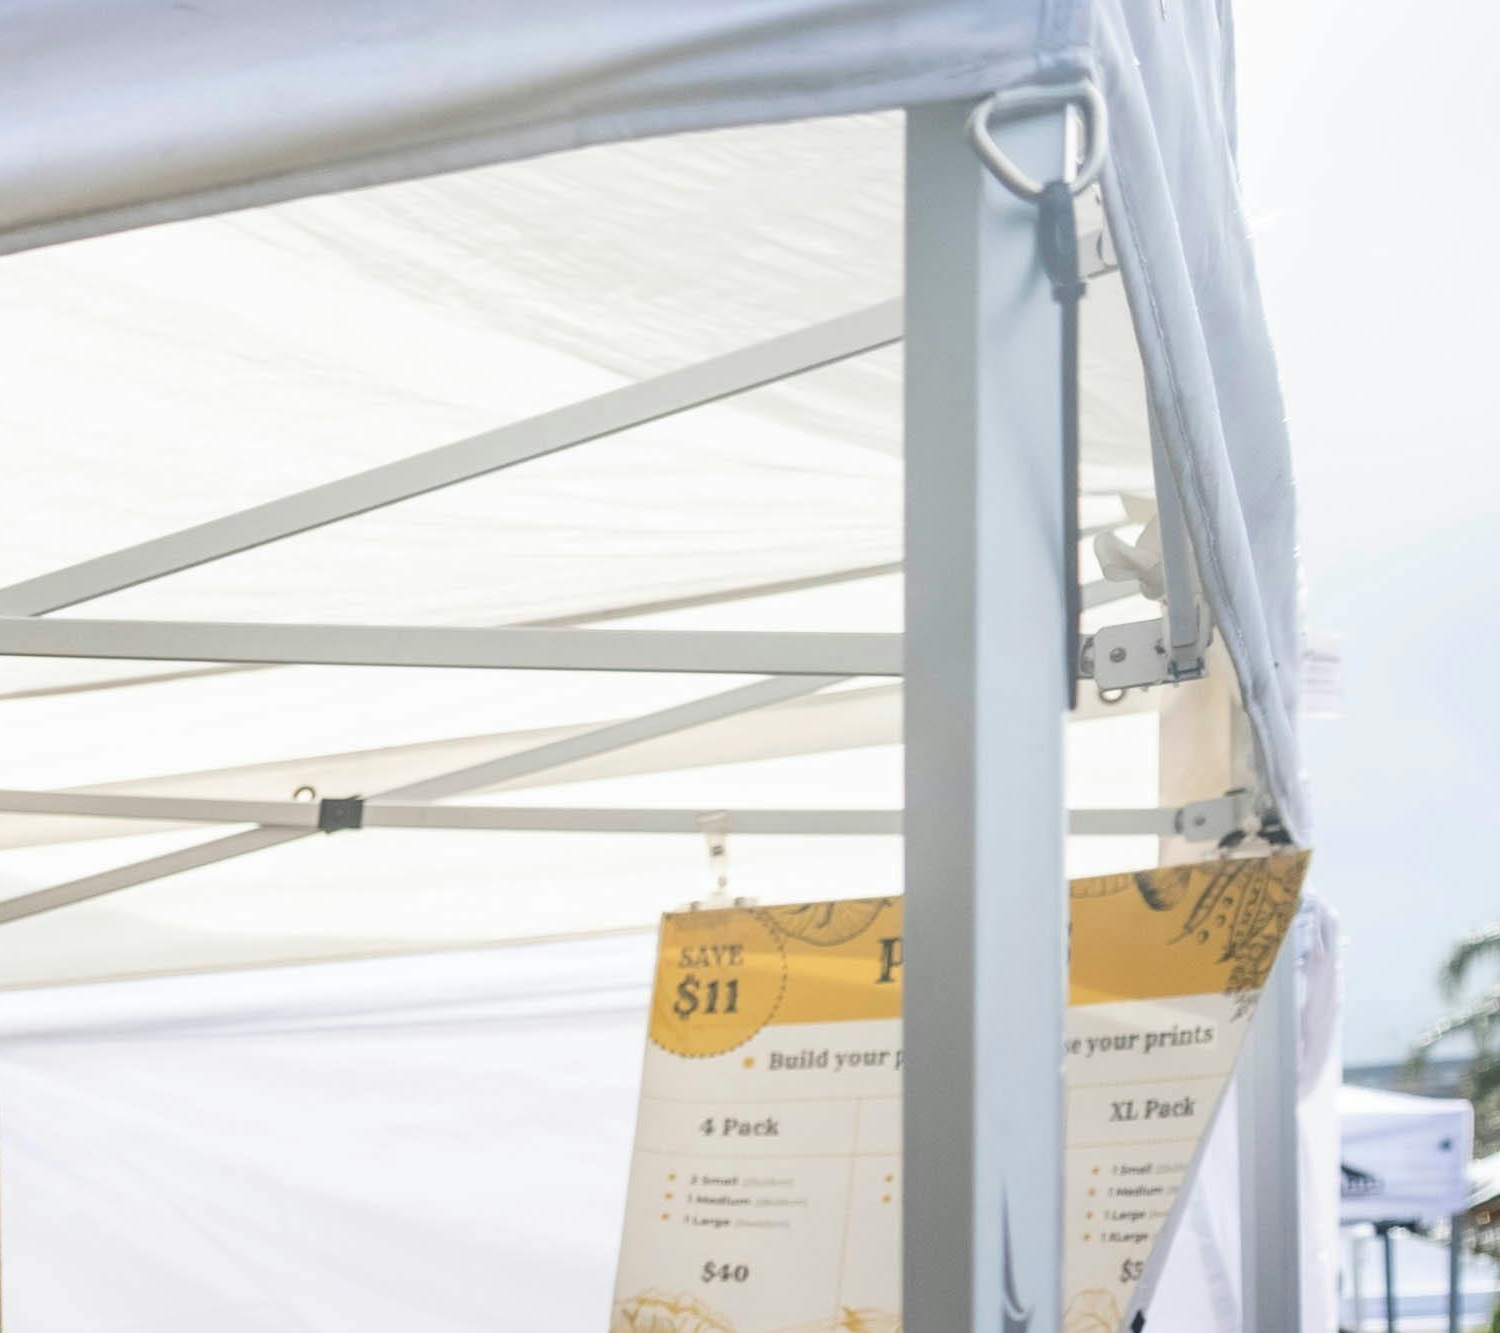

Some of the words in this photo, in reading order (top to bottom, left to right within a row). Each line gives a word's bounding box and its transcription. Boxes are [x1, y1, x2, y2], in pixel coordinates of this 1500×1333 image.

[677, 944, 745, 969] SAVE
[672, 978, 739, 1022] $11
[1086, 1029, 1138, 1058] your
[1145, 1022, 1215, 1052] prints
[769, 1050, 828, 1071] Build
[834, 1050, 888, 1072] your
[1110, 1101, 1139, 1122] XL
[1144, 1097, 1196, 1120] Pack
[699, 1118, 716, 1138] 4
[722, 1116, 781, 1138] Pack
[701, 1261, 750, 1283] $40
